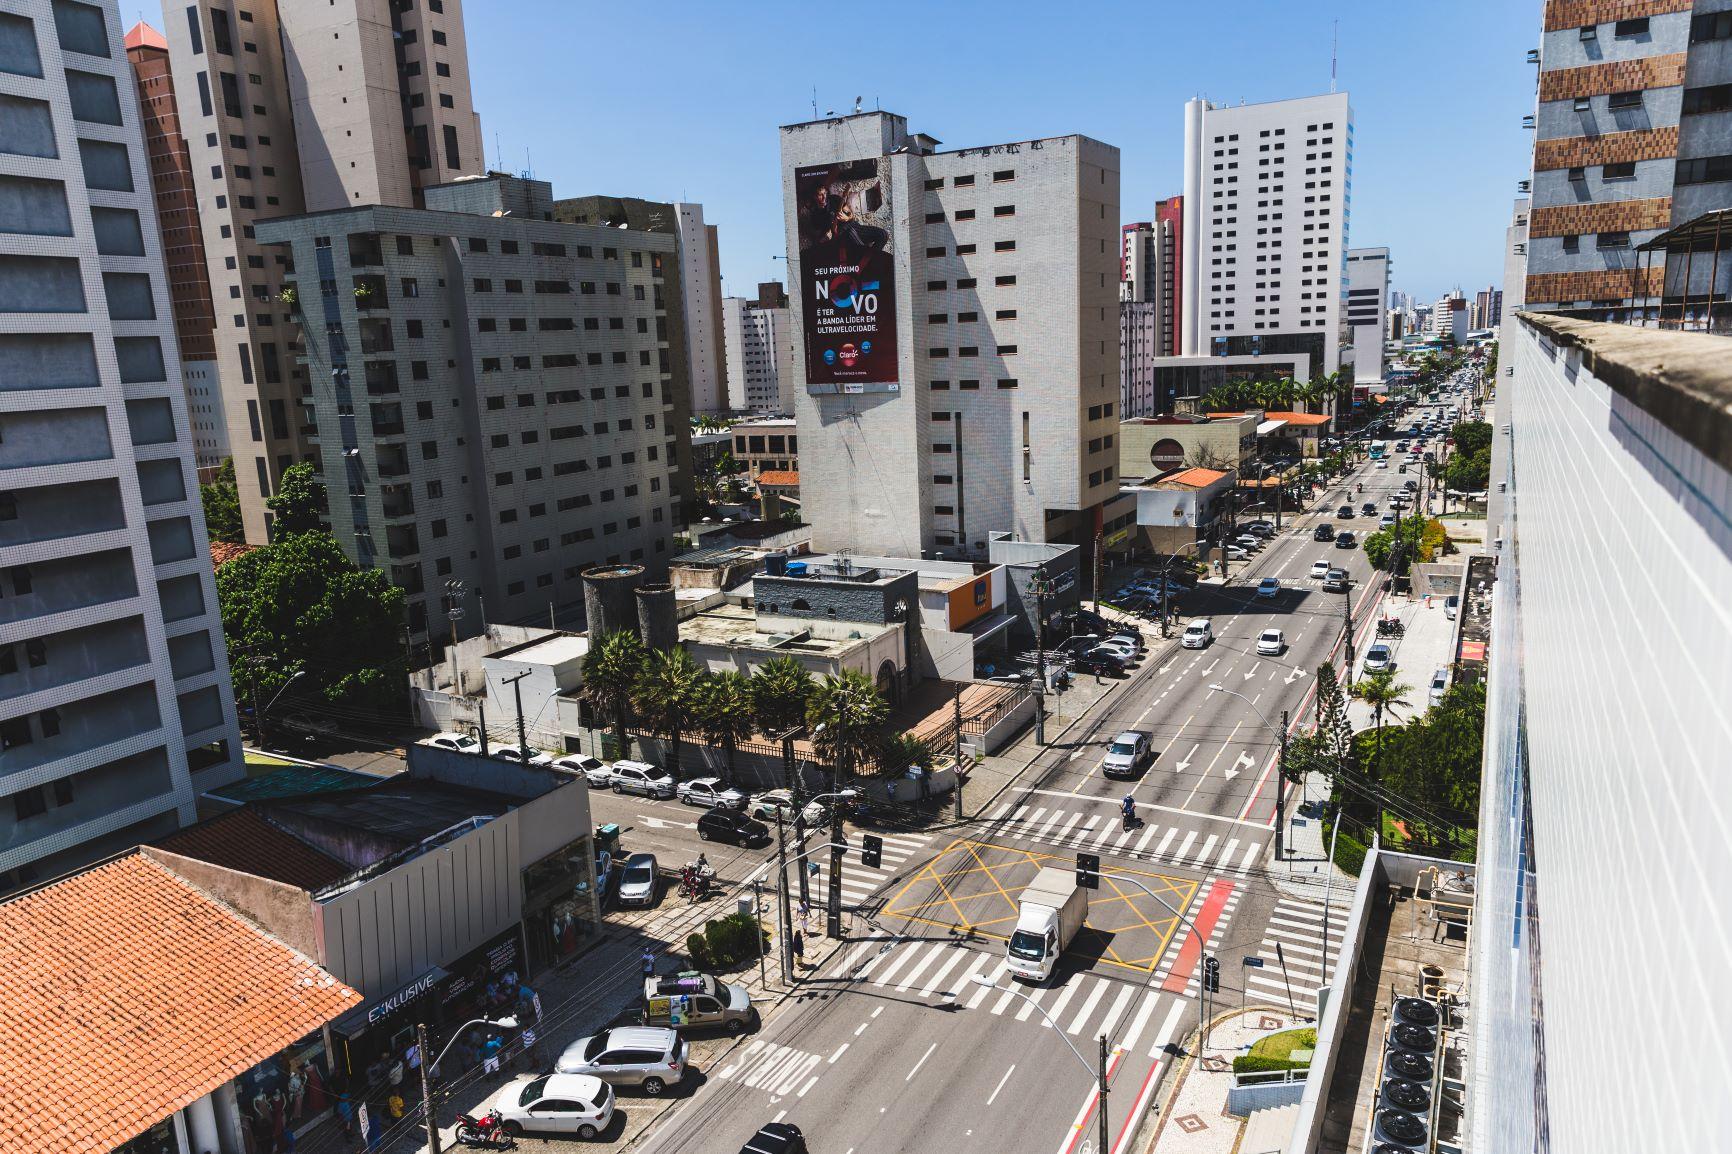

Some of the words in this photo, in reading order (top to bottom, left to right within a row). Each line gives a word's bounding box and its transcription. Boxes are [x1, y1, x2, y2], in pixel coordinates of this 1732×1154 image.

[830, 265, 860, 274] PRÓXIMO
[816, 308, 821, 316] É
[822, 317, 844, 325] BANDA
[846, 315, 864, 324] LÍDER
[817, 324, 878, 334] ULTRAVELOCIDADE.
